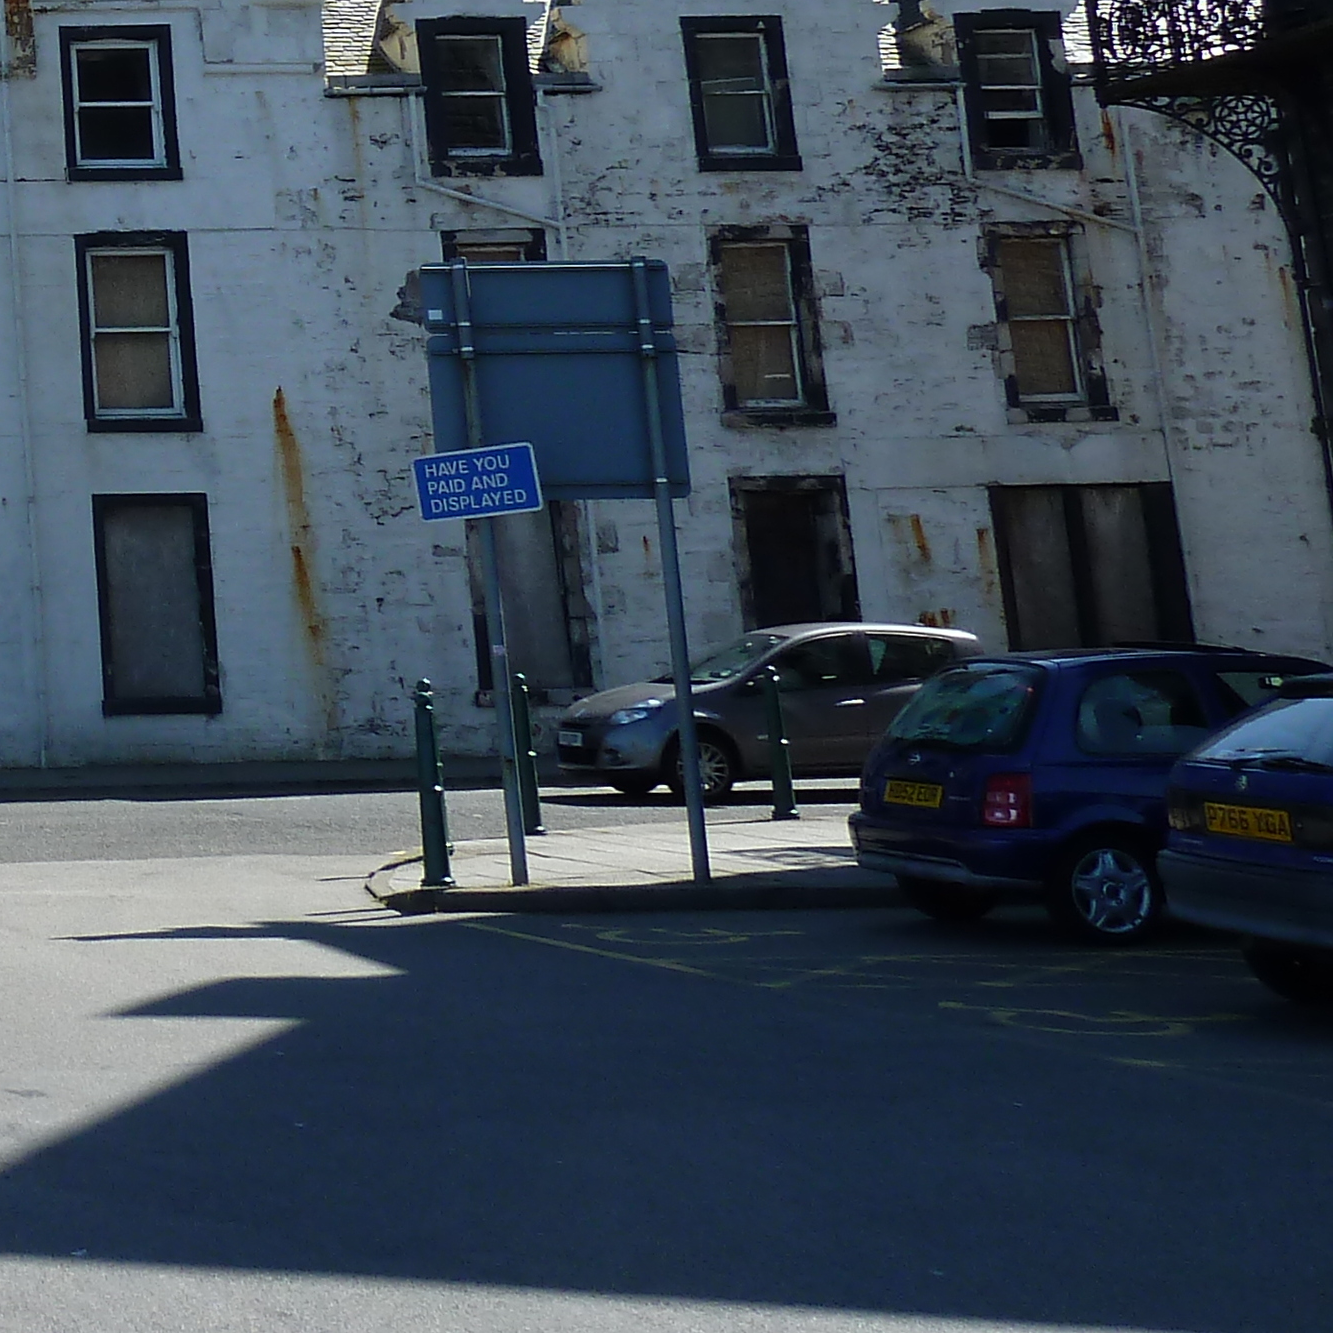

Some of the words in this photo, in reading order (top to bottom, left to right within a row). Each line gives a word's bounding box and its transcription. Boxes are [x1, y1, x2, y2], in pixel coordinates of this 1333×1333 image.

[425, 460, 469, 478] HAVE
[473, 454, 510, 472] YOU
[427, 478, 465, 495] PAID
[471, 473, 508, 491] AND
[430, 489, 527, 513] DISPLAYED
[1206, 805, 1249, 830] P766
[1252, 812, 1289, 837] YGA
